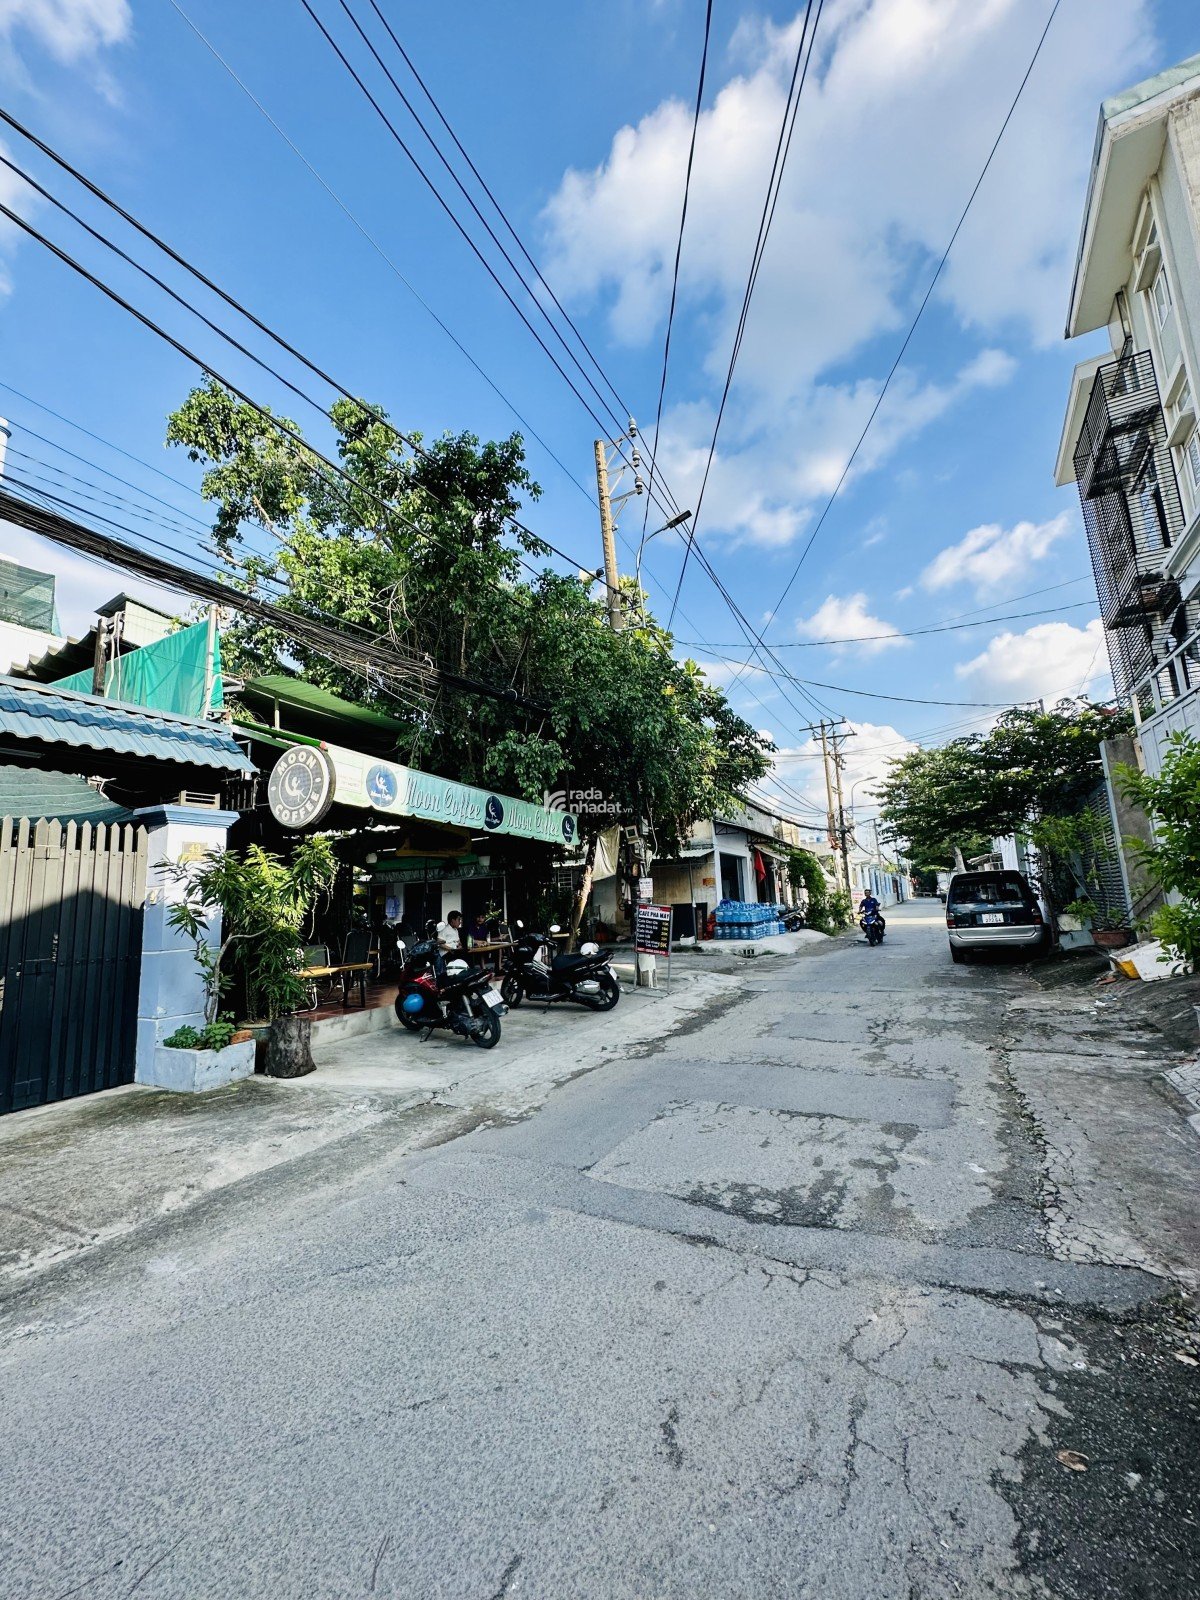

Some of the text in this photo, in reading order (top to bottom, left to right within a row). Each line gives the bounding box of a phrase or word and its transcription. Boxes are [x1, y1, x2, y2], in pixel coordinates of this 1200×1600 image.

[277, 751, 316, 776] MOON
[275, 791, 320, 822] COFFEE
[401, 777, 441, 813] Moon
[444, 787, 482, 824] Coffee
[507, 807, 560, 838] Moon Coffee
